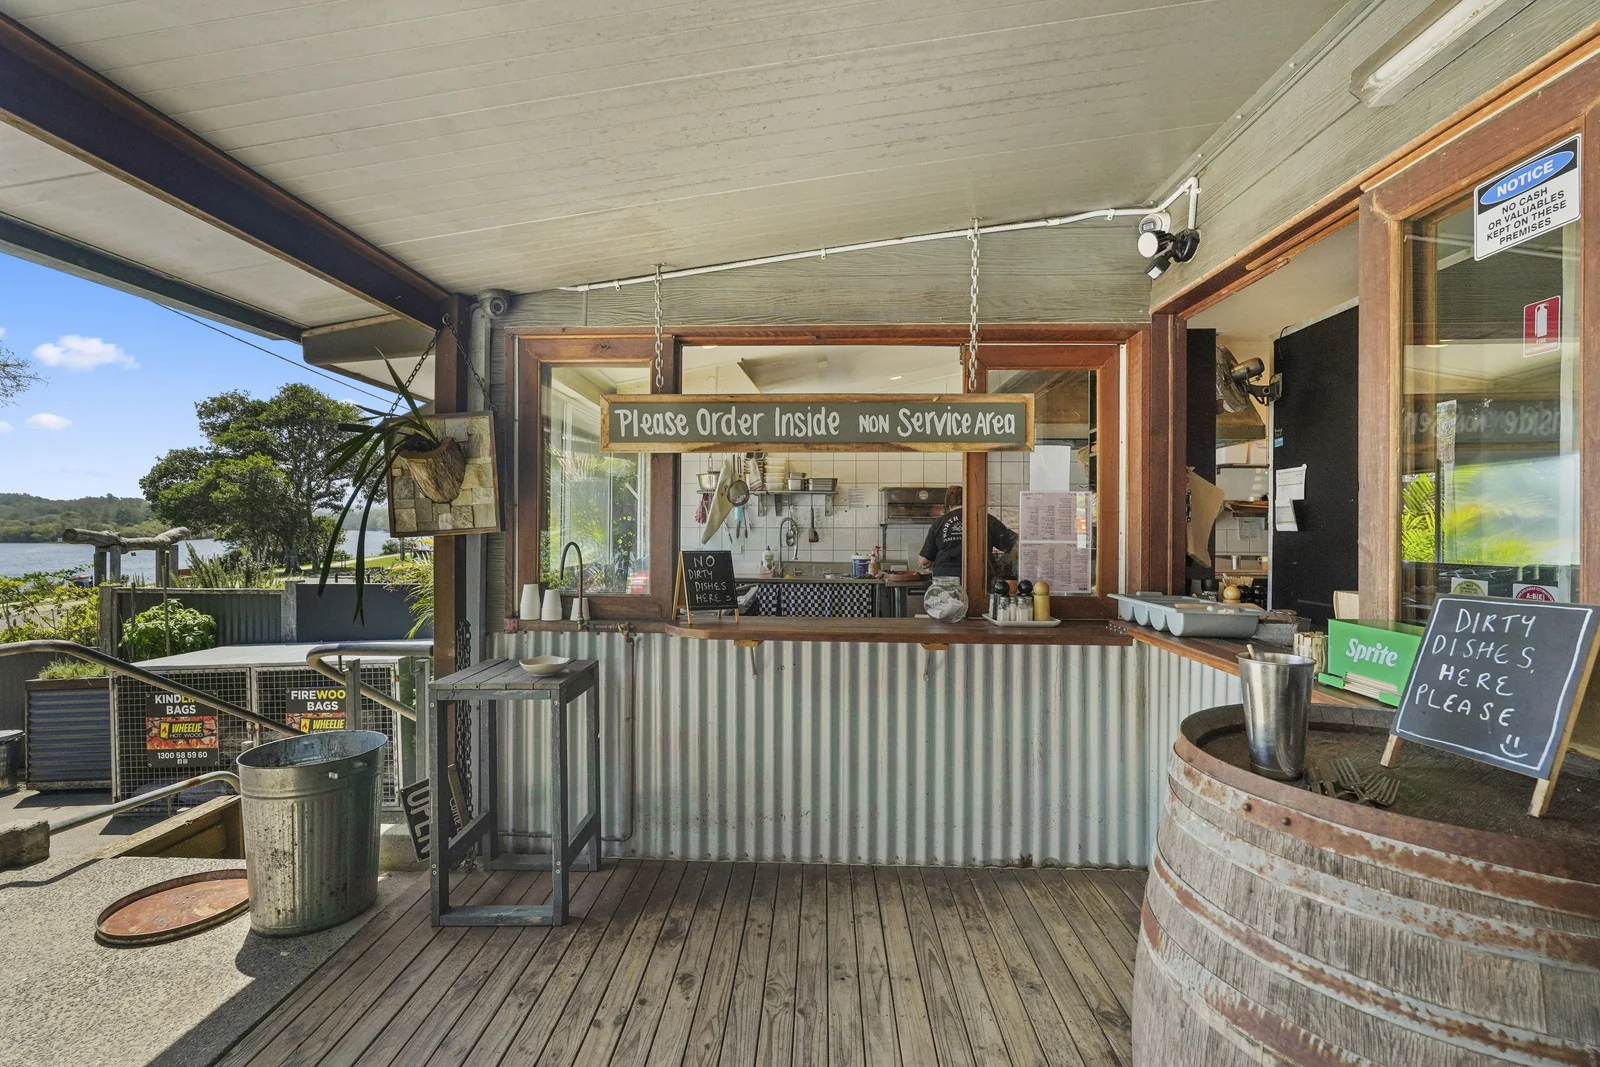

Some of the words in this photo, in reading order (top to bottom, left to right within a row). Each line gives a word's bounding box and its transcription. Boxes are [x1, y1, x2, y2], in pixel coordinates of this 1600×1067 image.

[1497, 159, 1554, 198] NOTICE
[1488, 218, 1501, 230] OR
[1504, 190, 1565, 224] VALUABLES
[1502, 201, 1516, 214] NO
[1519, 186, 1548, 207] CASH
[1486, 225, 1510, 241] KEPT
[1514, 216, 1528, 229] ON
[1531, 200, 1567, 221] THESE
[1500, 217, 1552, 245] PREMISES
[614, 409, 689, 438] Please
[696, 406, 764, 437] Order
[774, 406, 840, 438] Inside
[859, 414, 890, 433] NON
[897, 406, 970, 438] Service
[974, 412, 1015, 436] Area
[688, 569, 712, 580] DIRTY
[694, 555, 715, 567] NO
[695, 582, 727, 591] DISHES
[696, 594, 721, 603] HERE
[1455, 608, 1537, 637] DIRTY
[1346, 638, 1398, 667] Sprite
[1439, 663, 1514, 696] HERE
[291, 690, 346, 700] FIREWOO
[307, 701, 338, 711] BAGS
[1415, 684, 1516, 727] PLEASE
[166, 705, 196, 714] BAGS
[172, 723, 202, 732] WHEELIE
[313, 719, 344, 729] WHEELIE
